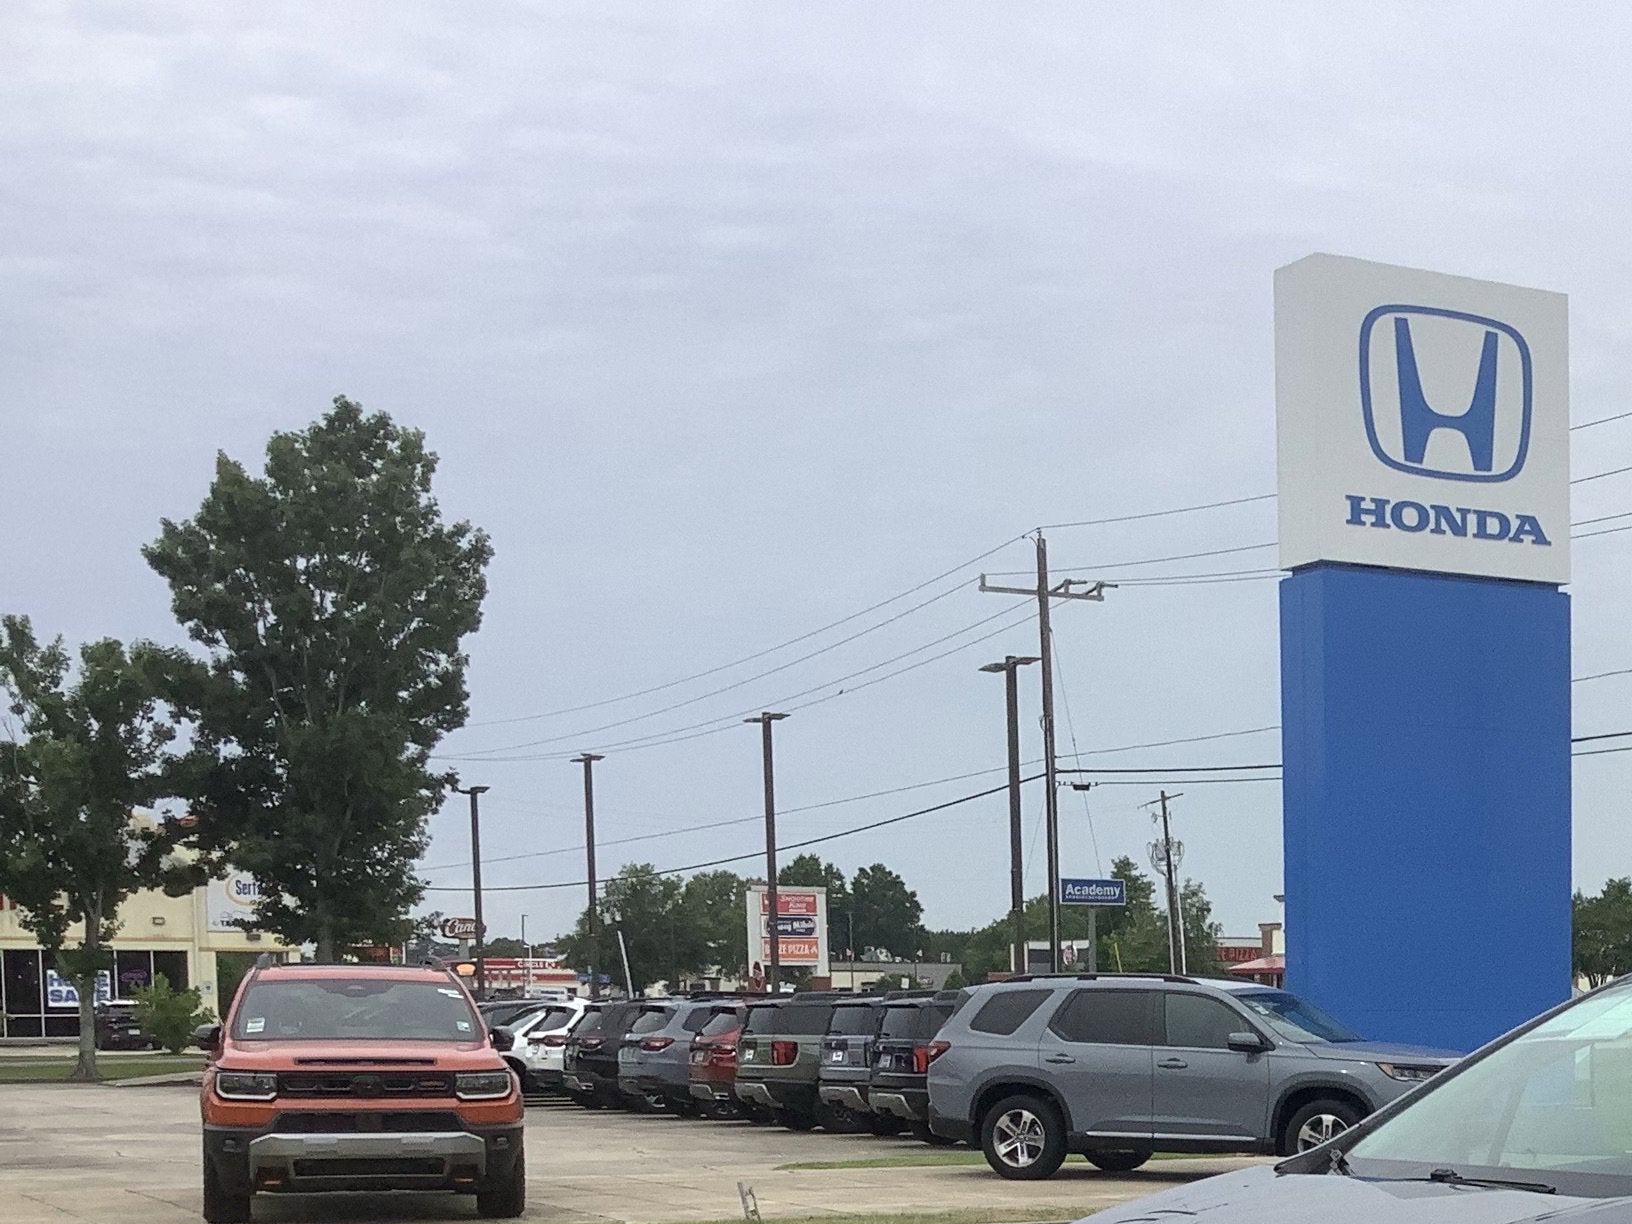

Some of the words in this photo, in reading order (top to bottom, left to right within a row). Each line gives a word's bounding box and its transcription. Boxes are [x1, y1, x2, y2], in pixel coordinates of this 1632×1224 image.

[1345, 494, 1552, 546] HONDA
[1065, 883, 1121, 900] Academy
[49, 989, 109, 1002] SAE
